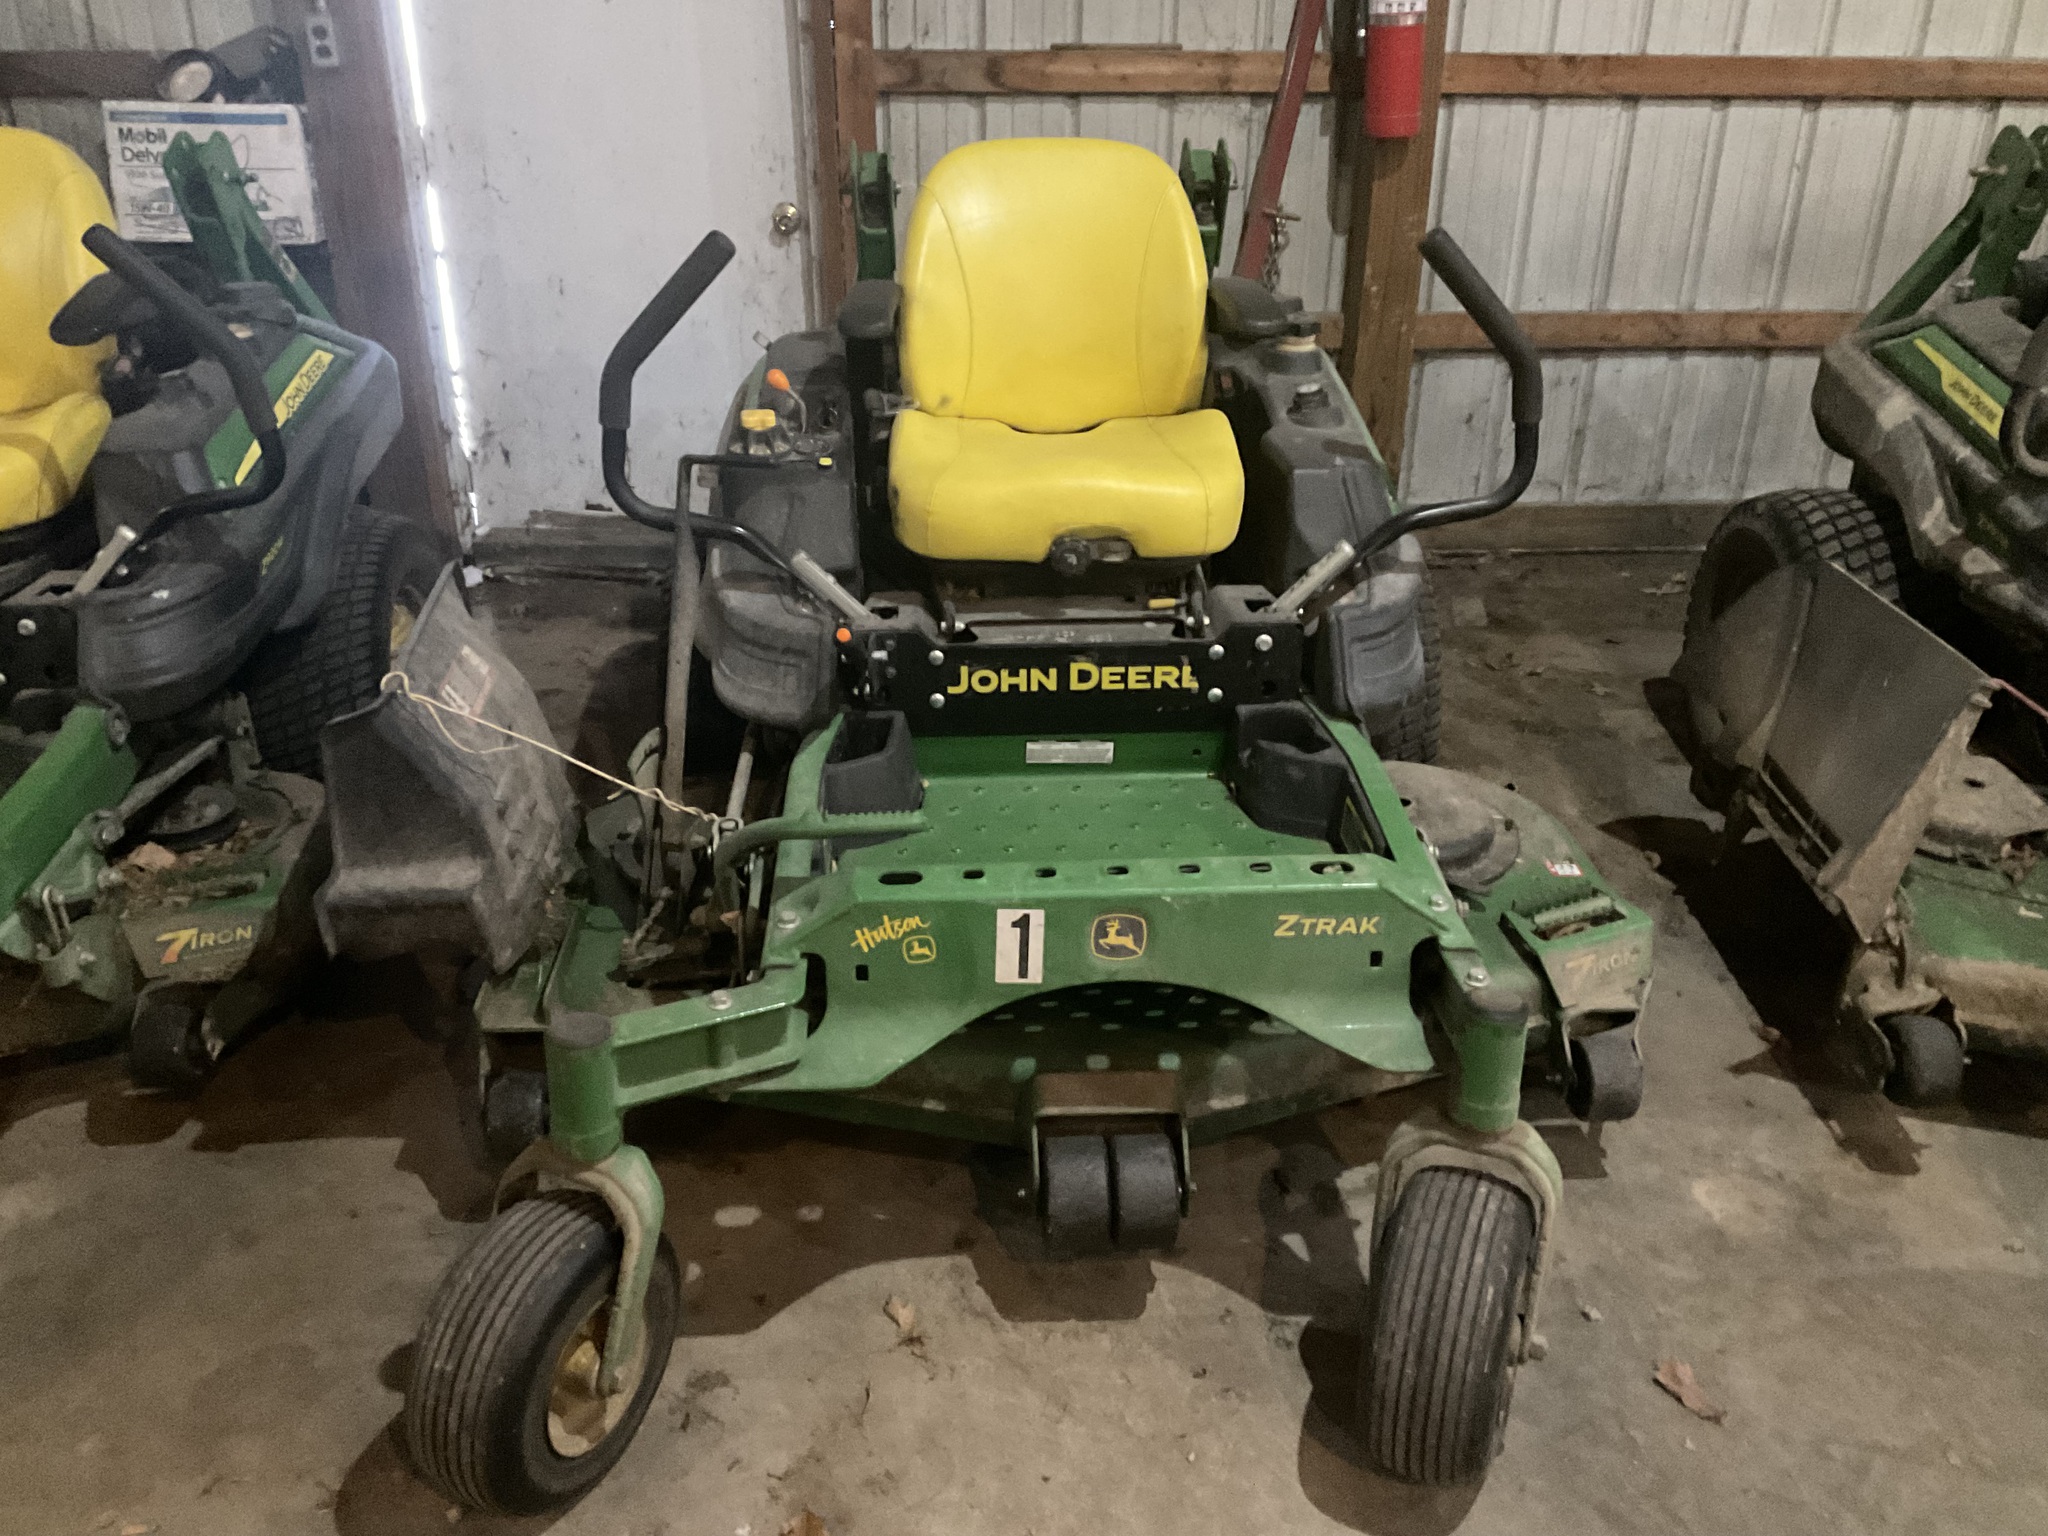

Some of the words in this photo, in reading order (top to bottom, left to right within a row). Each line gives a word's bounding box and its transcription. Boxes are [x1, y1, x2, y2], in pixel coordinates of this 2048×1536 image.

[118, 127, 167, 144] Mobil
[121, 147, 163, 164] Delv
[946, 665, 1058, 695] JOHN
[850, 914, 932, 953] Hutson
[1011, 913, 1031, 979] 1
